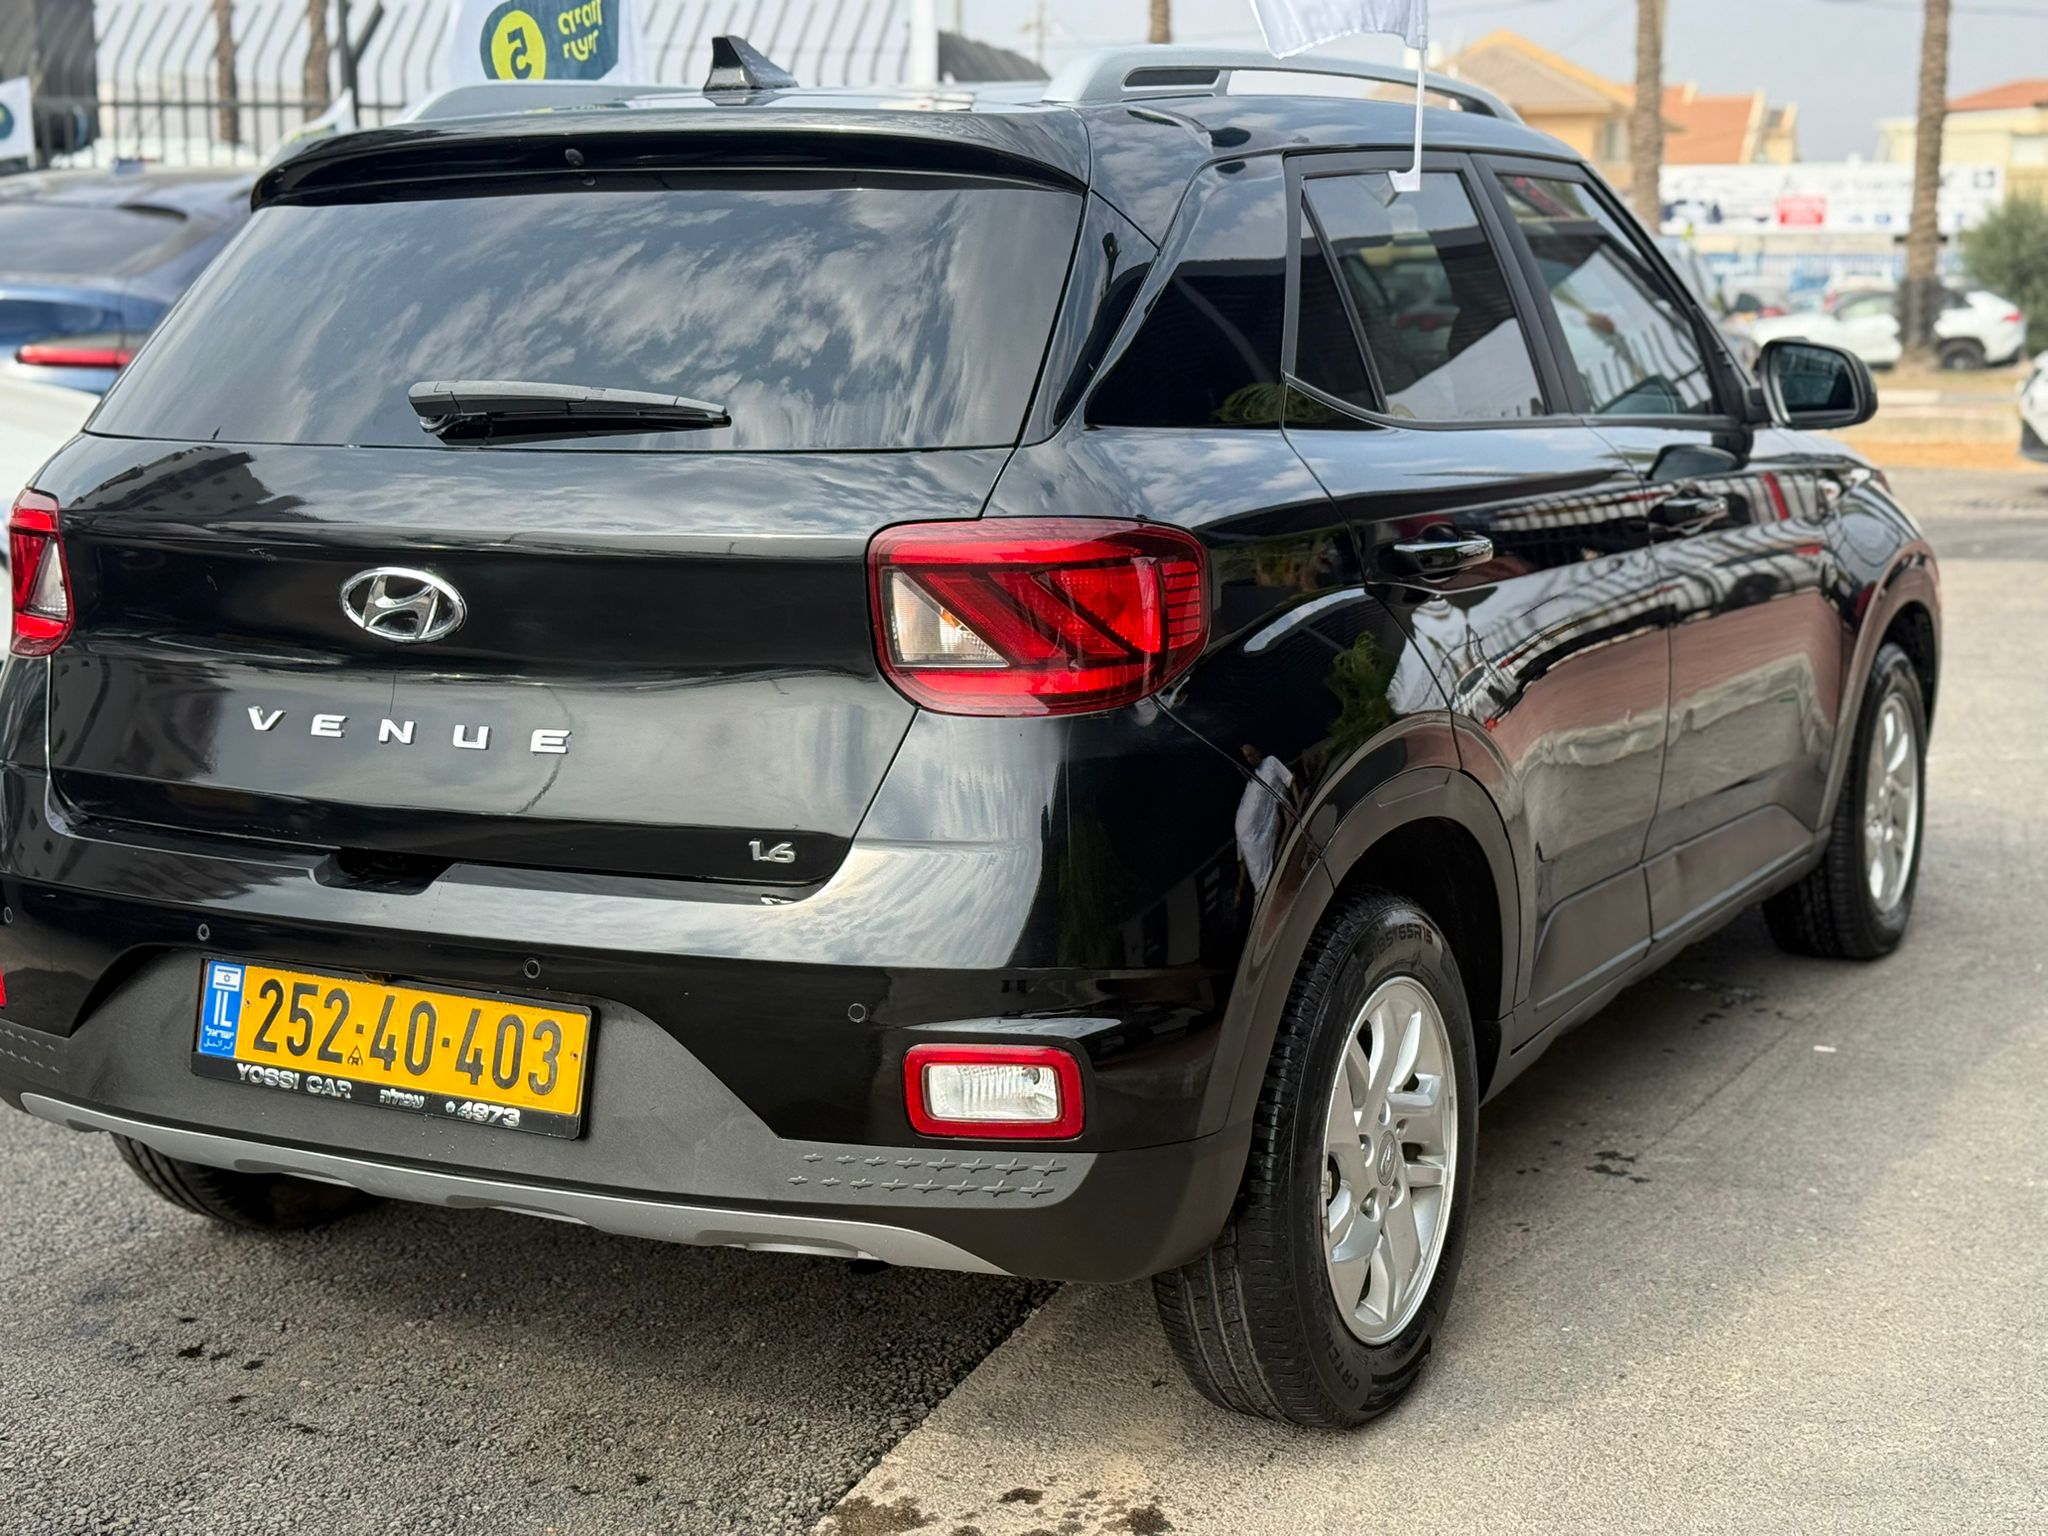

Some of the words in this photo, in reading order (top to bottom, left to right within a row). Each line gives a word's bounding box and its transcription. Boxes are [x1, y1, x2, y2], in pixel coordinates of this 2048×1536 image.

[248, 706, 572, 755] VENUE
[213, 990, 233, 1028] IL
[205, 1025, 234, 1040] ישראל
[236, 1062, 300, 1090] YOSSI
[305, 1075, 352, 1099] CAR
[379, 1088, 425, 1109] עפולה
